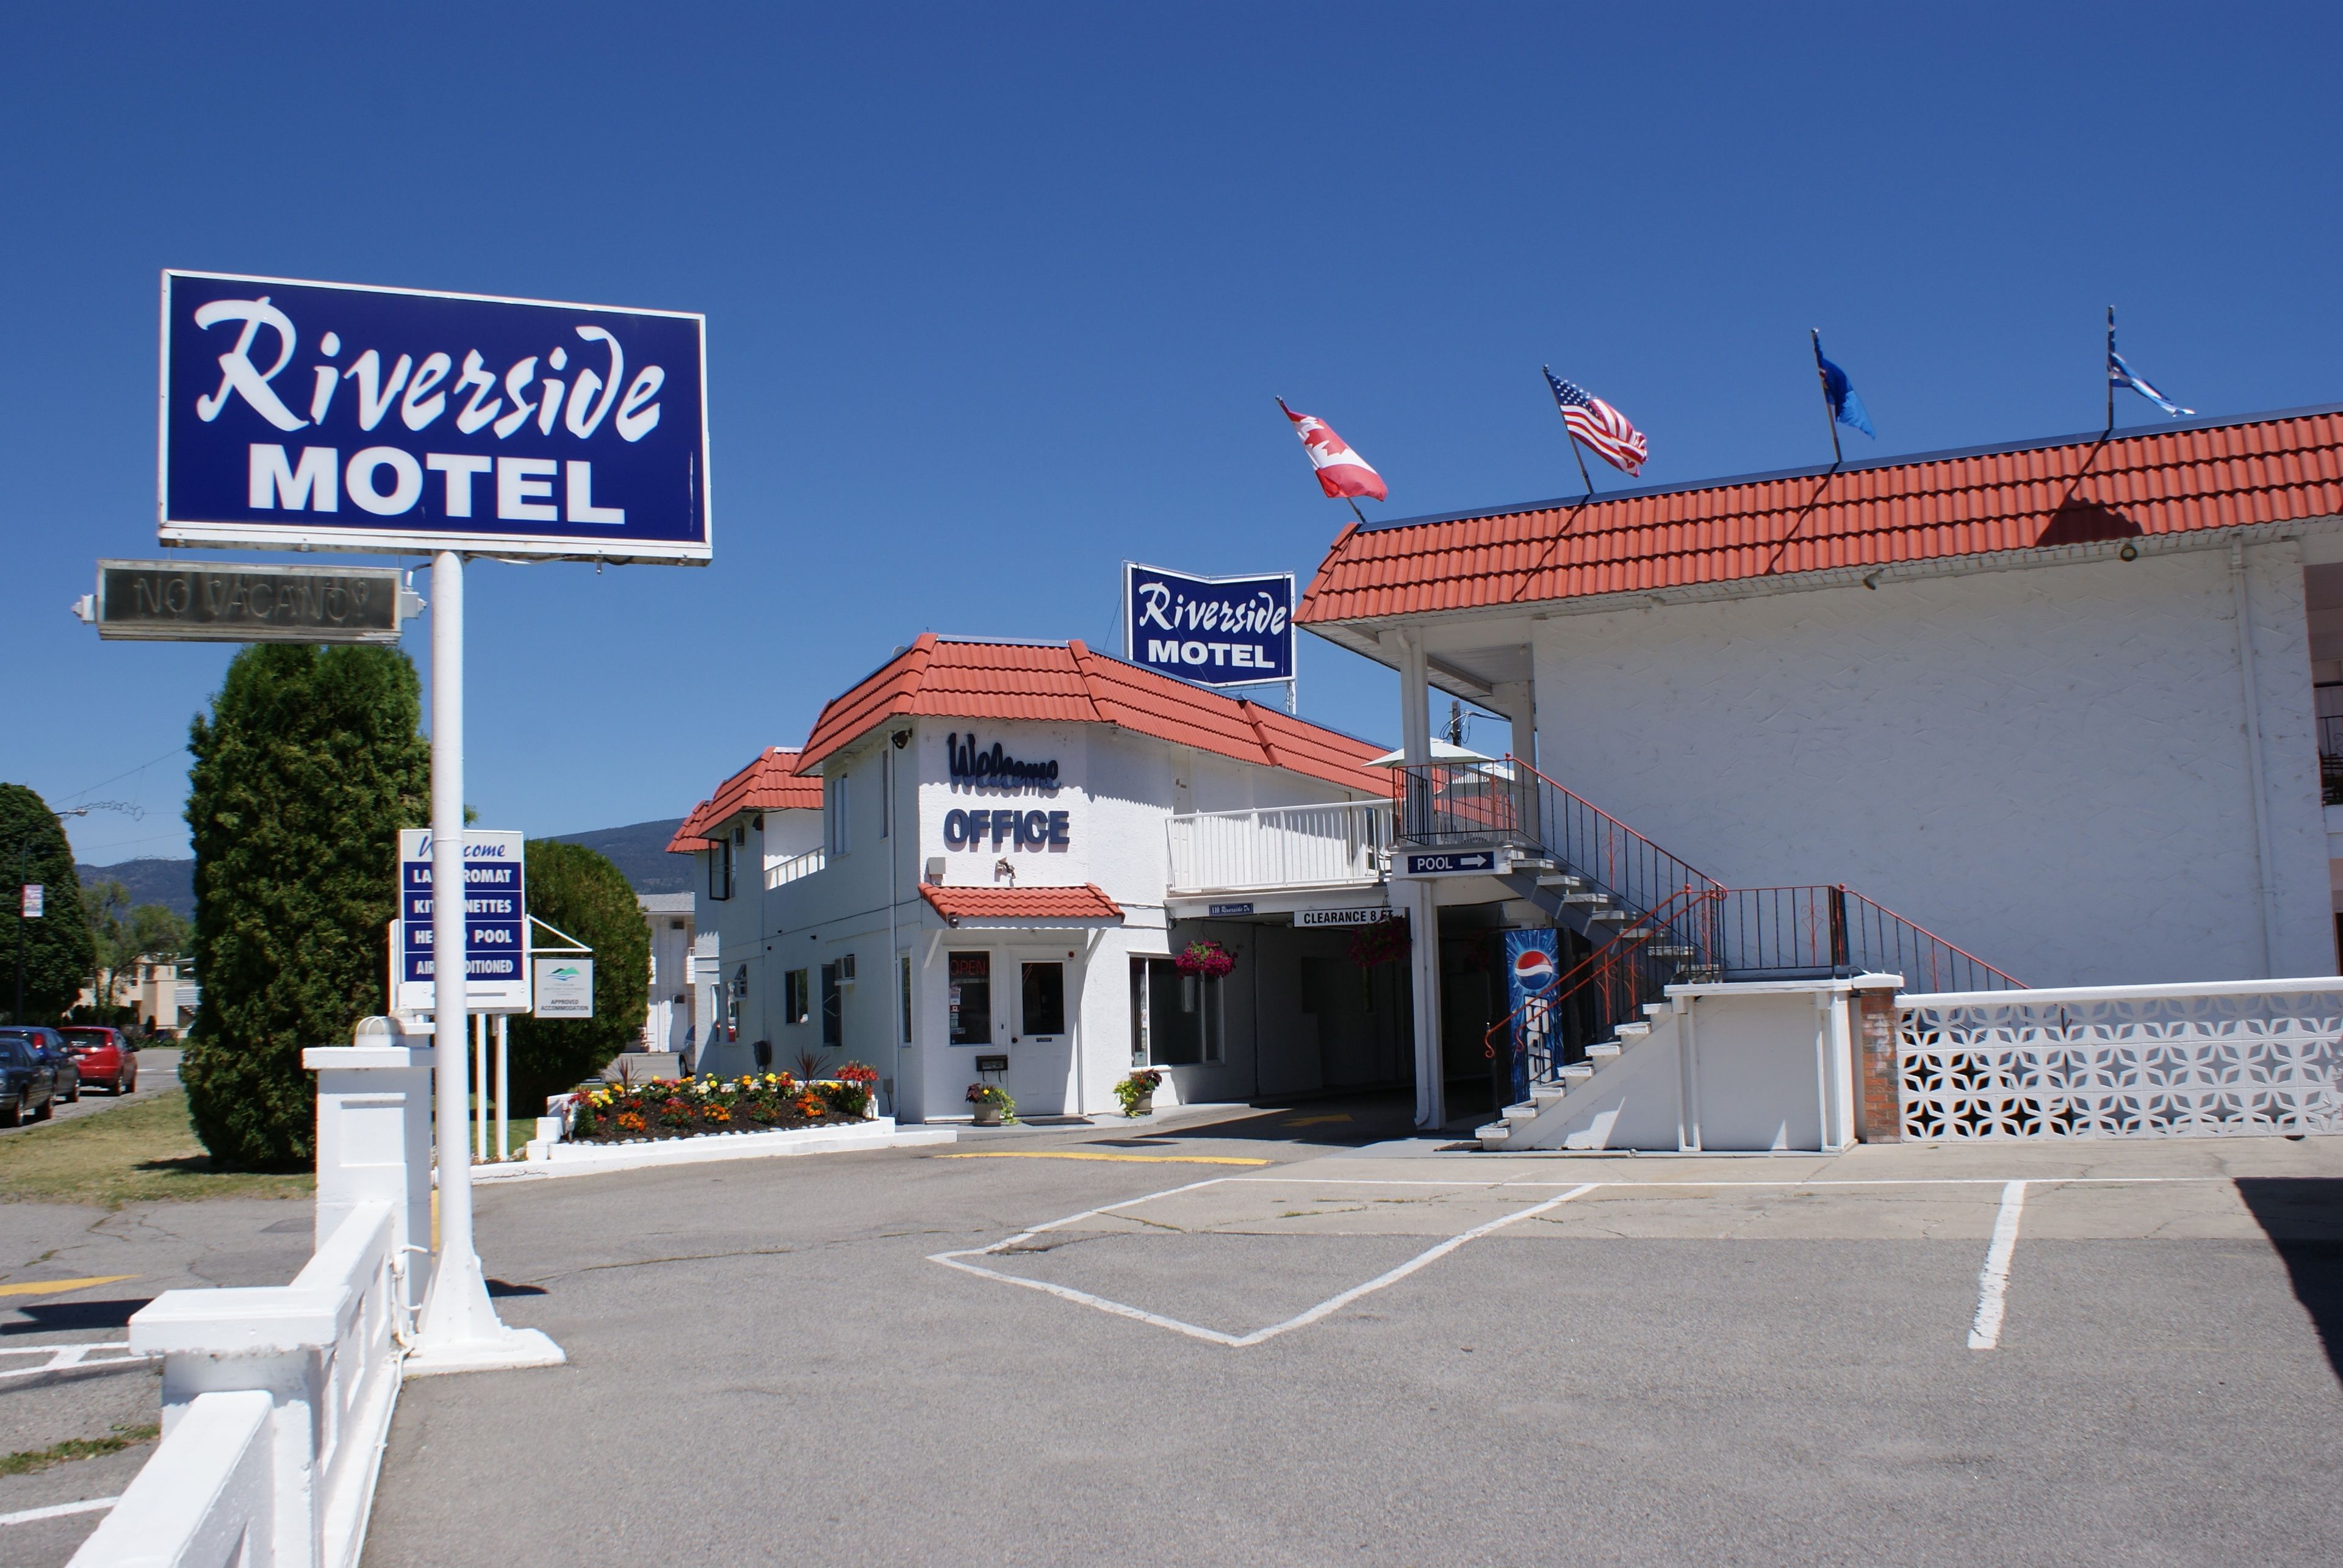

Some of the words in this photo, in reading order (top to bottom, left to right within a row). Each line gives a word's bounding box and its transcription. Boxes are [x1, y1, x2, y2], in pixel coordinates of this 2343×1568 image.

[194, 297, 664, 442] Riverside
[249, 444, 625, 524] MOTEL
[135, 578, 191, 613] NO
[1139, 582, 1287, 635] Riverside
[1148, 639, 1275, 668] MOTEL
[948, 732, 1062, 791] Welcome
[944, 808, 1070, 844] OFFICE
[414, 869, 512, 883] LAROMAT
[1417, 857, 1453, 871] POOL
[1304, 911, 1366, 924] CLEARANCE
[1370, 910, 1377, 921] 8
[474, 929, 513, 943] POOL
[950, 960, 985, 976] OPEN
[1525, 996, 1551, 1085] EPSI
